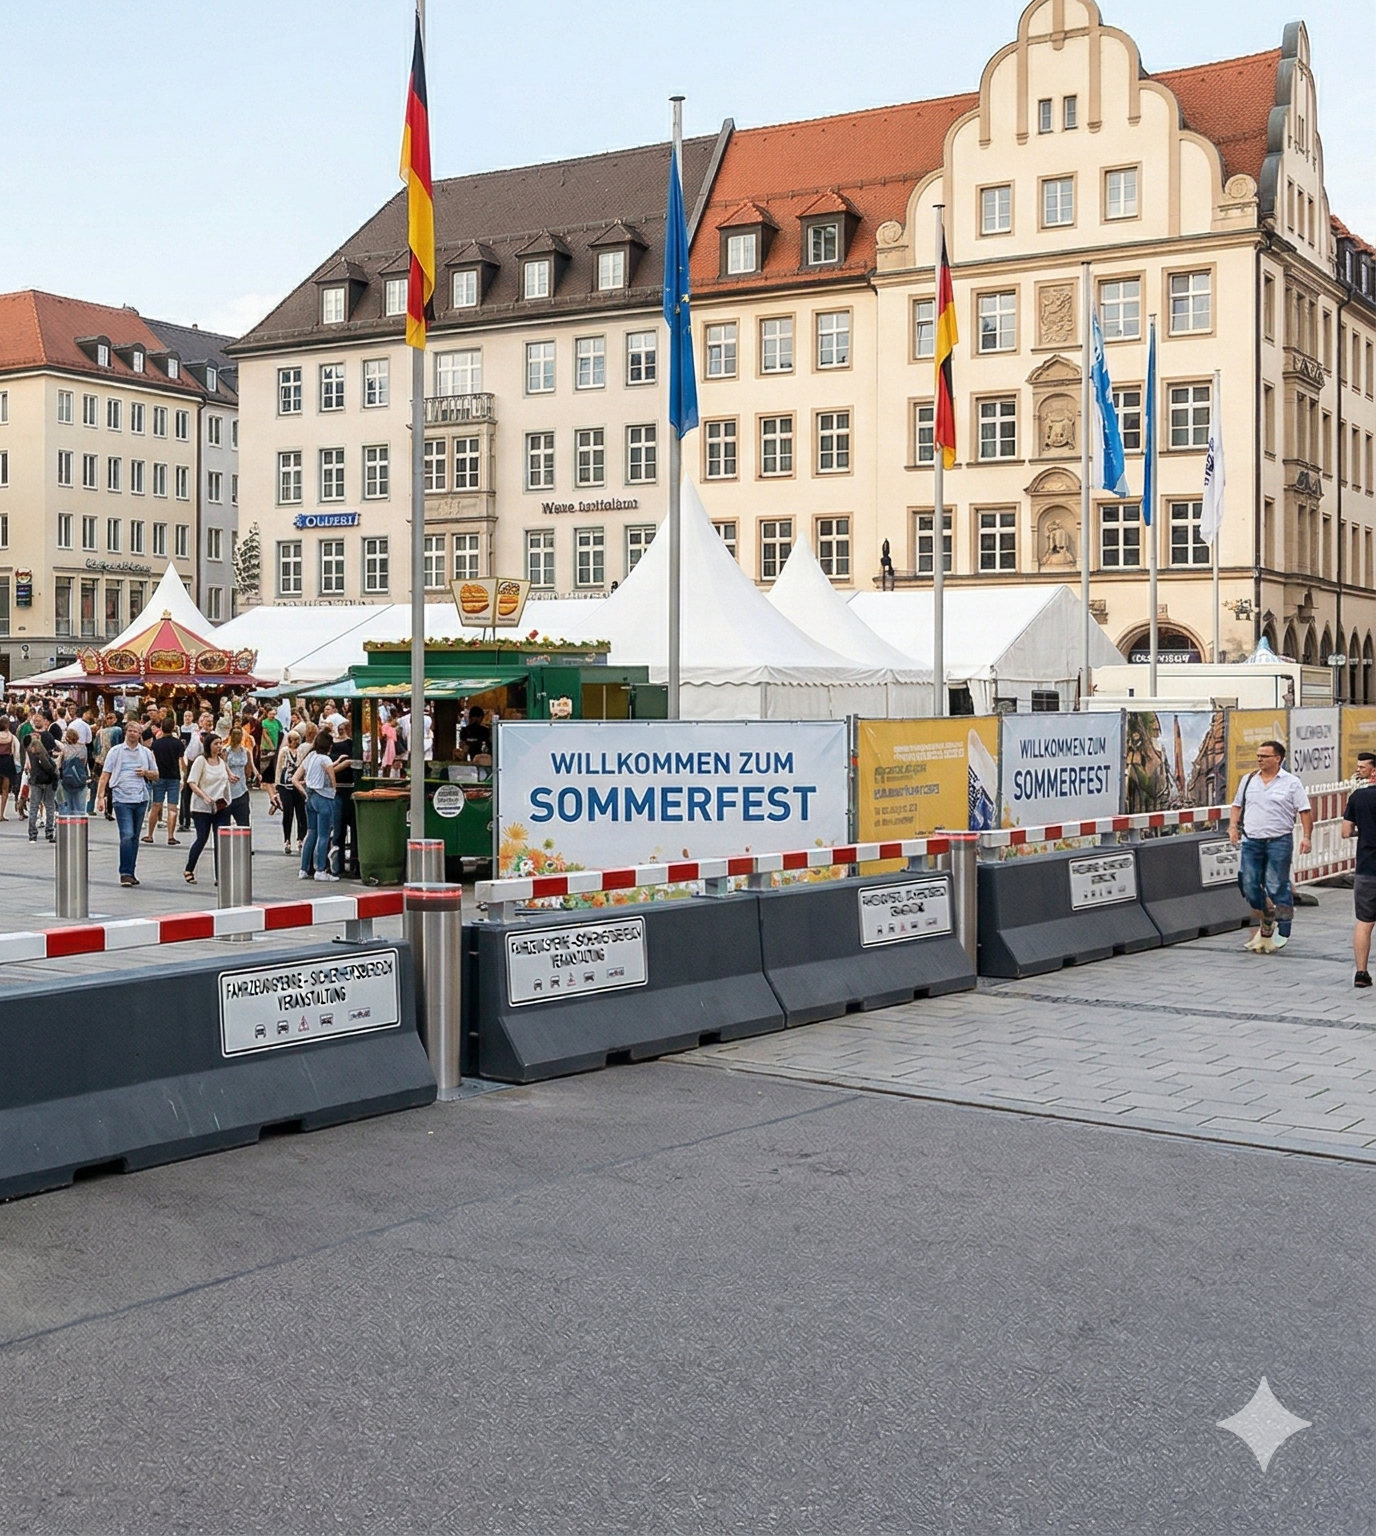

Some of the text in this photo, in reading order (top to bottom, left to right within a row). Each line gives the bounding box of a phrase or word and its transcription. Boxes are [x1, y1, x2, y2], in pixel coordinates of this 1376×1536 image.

[550, 751, 794, 775] WILLKOMMEN ZUM
[1019, 737, 1086, 759] WILLKOMMEN
[1014, 764, 1111, 801] SOMMERFEST
[529, 785, 817, 823] SOMMERFEST
